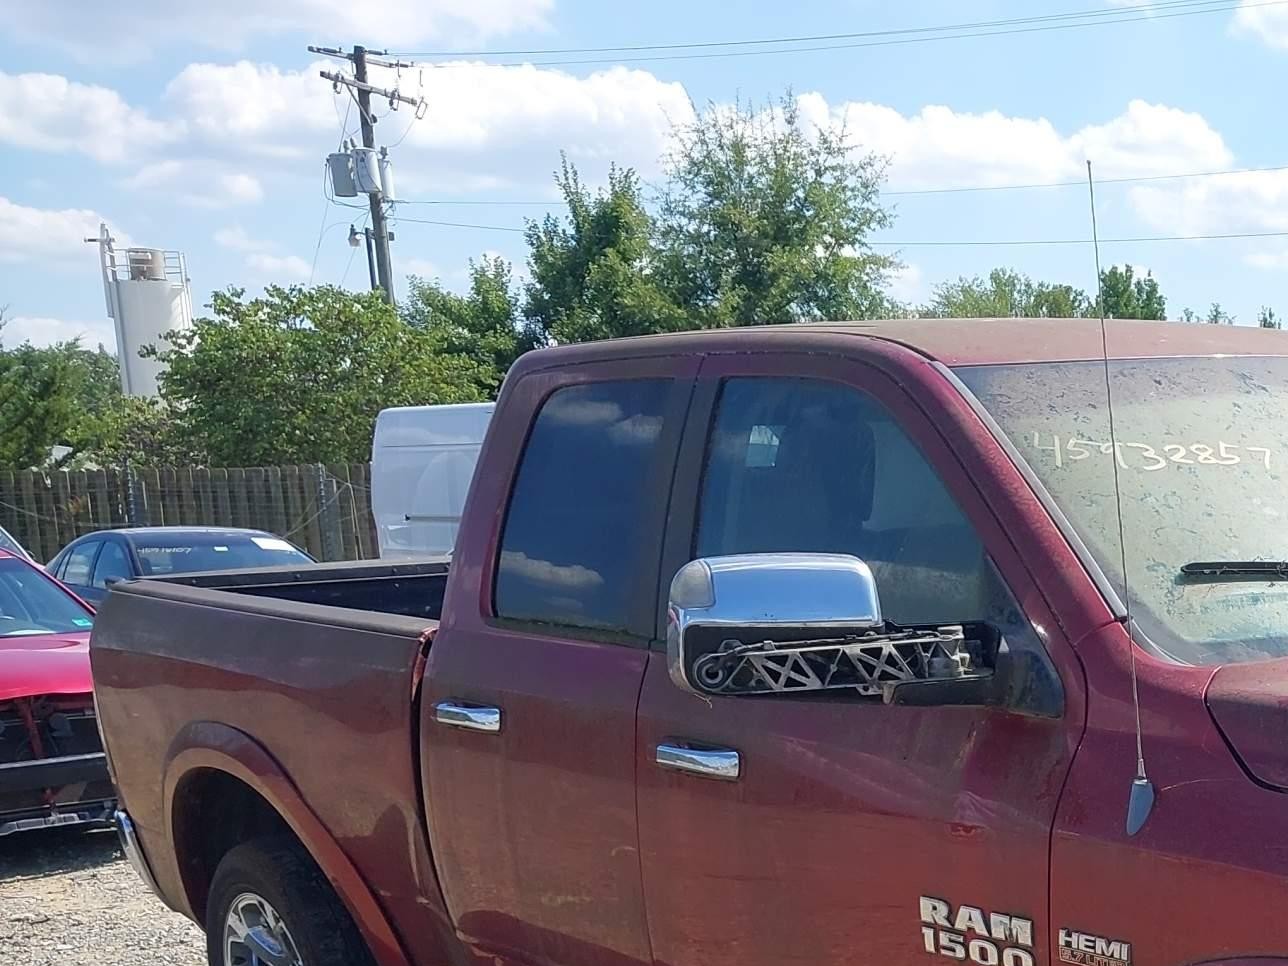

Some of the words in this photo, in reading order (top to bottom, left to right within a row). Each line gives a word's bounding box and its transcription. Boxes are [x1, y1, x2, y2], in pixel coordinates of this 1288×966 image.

[1033, 431, 1271, 471] 45932857
[919, 896, 1033, 947] RAM
[1059, 928, 1131, 961] HEMI
[1061, 947, 1084, 962] 5.7
